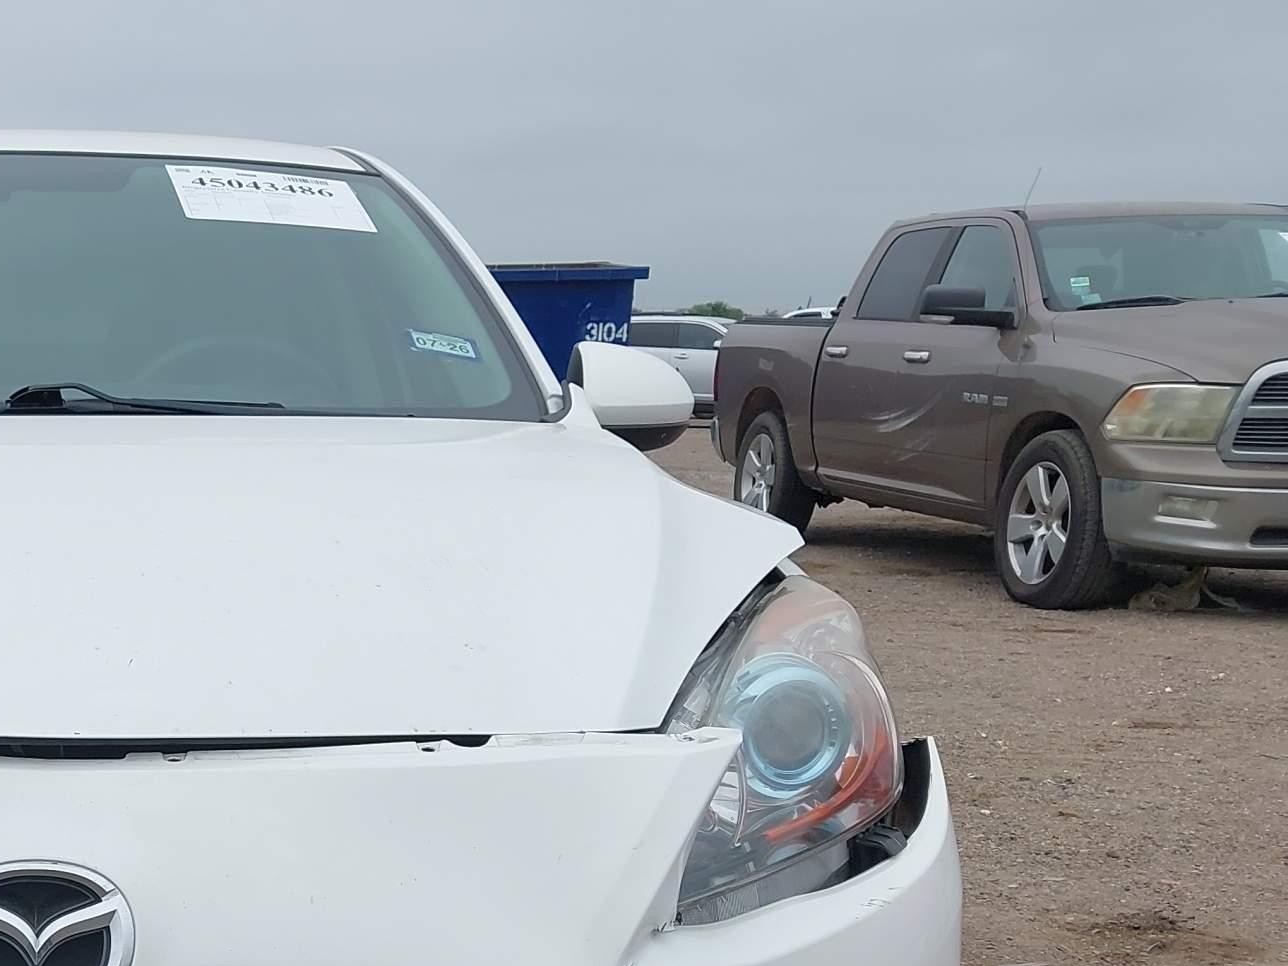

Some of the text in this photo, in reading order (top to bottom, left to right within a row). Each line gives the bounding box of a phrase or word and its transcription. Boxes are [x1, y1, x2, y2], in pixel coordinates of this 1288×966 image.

[191, 176, 334, 198] 45043486
[584, 322, 628, 342] 3104
[415, 336, 470, 354] 07-26
